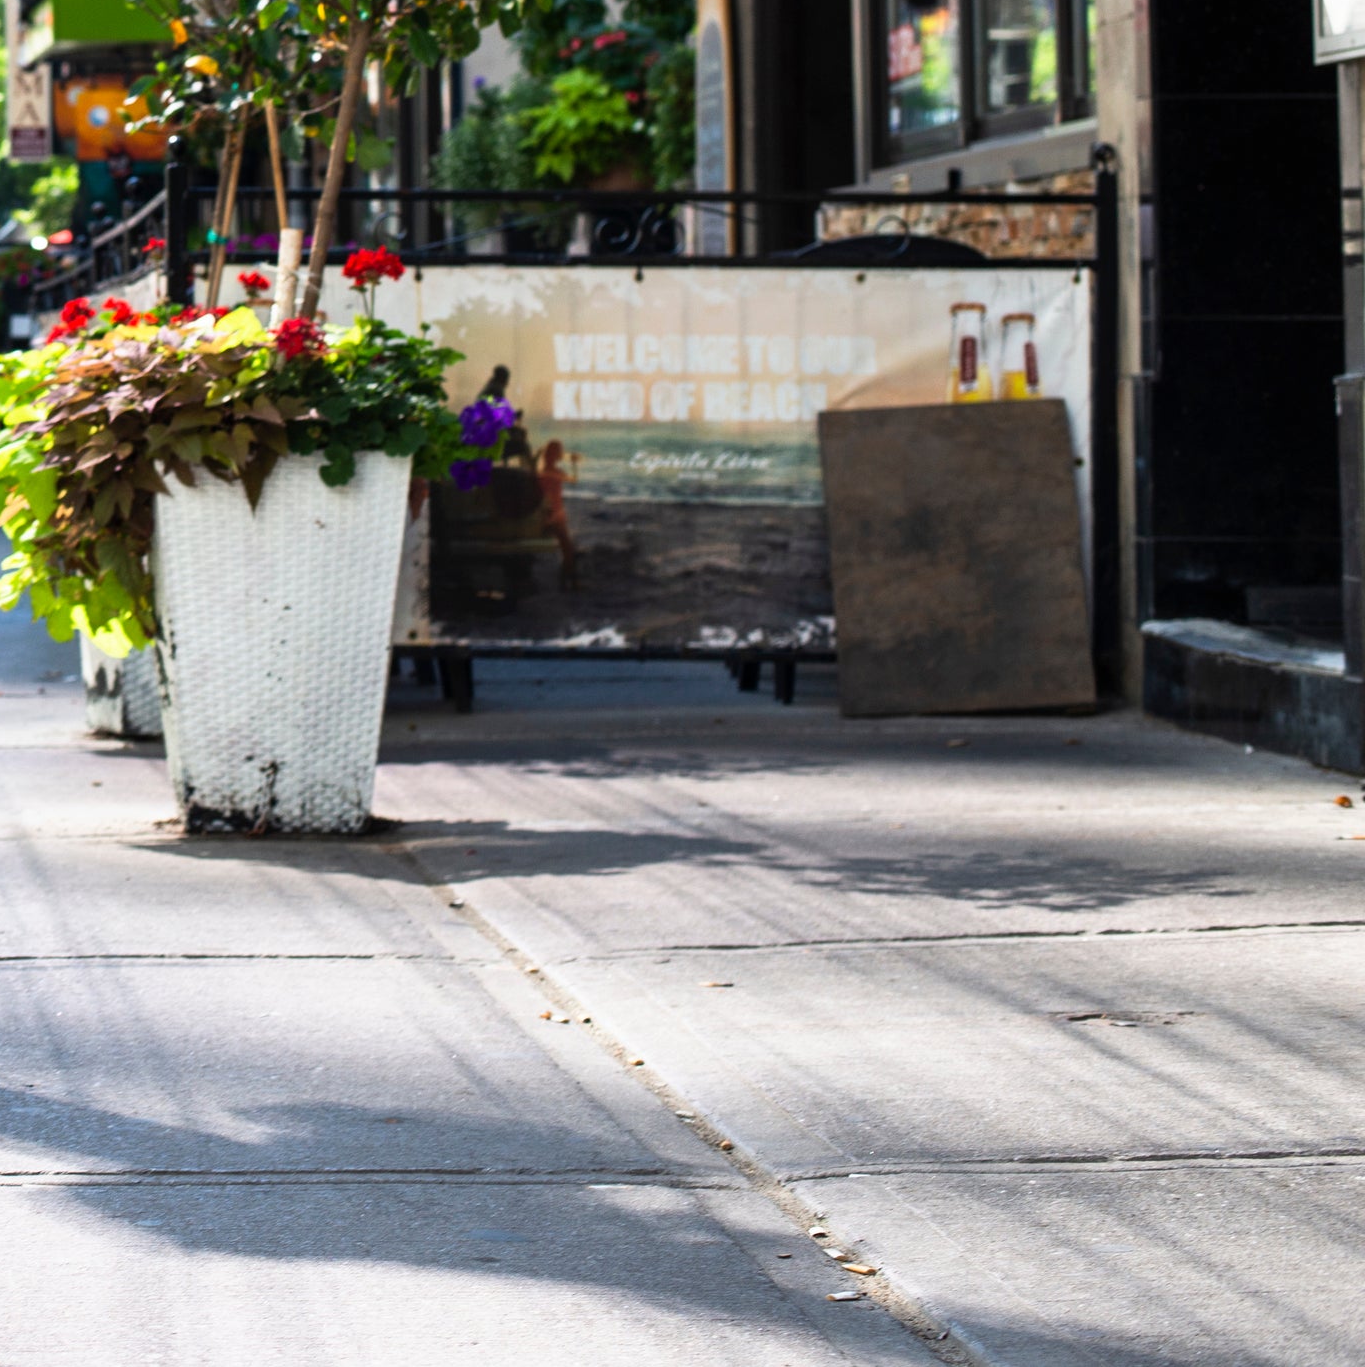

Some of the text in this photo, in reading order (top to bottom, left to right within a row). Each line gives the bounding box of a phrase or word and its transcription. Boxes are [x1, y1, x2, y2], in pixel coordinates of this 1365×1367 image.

[552, 334, 877, 375] WELCOME TO OUR
[552, 381, 828, 421] KIND OF BEACH
